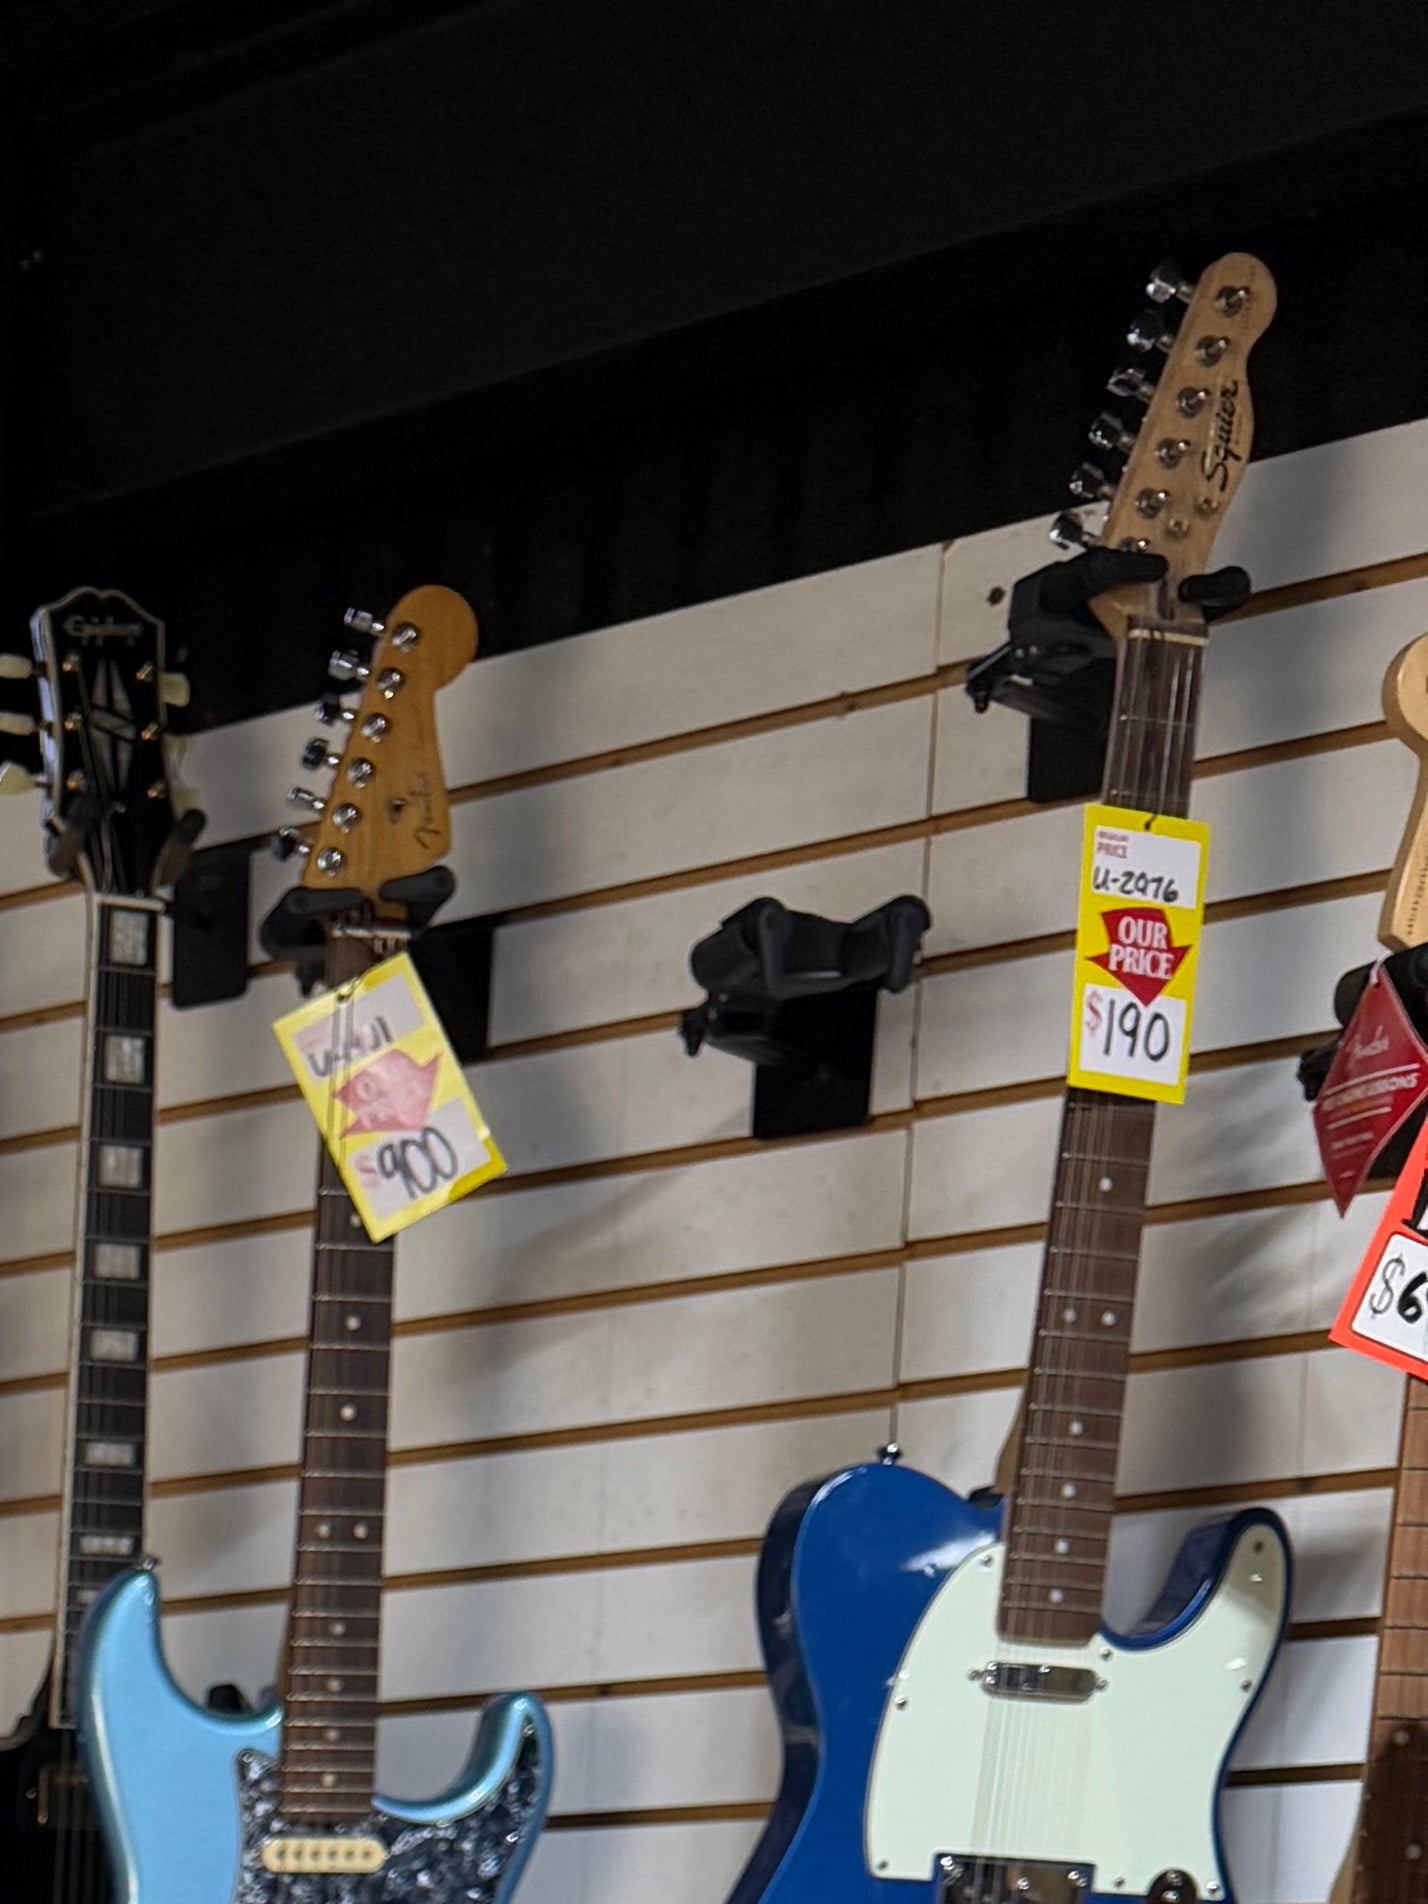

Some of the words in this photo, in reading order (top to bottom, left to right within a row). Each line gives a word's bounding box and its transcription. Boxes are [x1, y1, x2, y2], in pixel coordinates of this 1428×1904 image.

[1201, 379, 1242, 493] Squier
[1117, 914, 1169, 951] OUR
[1107, 943, 1175, 980] PRICE
